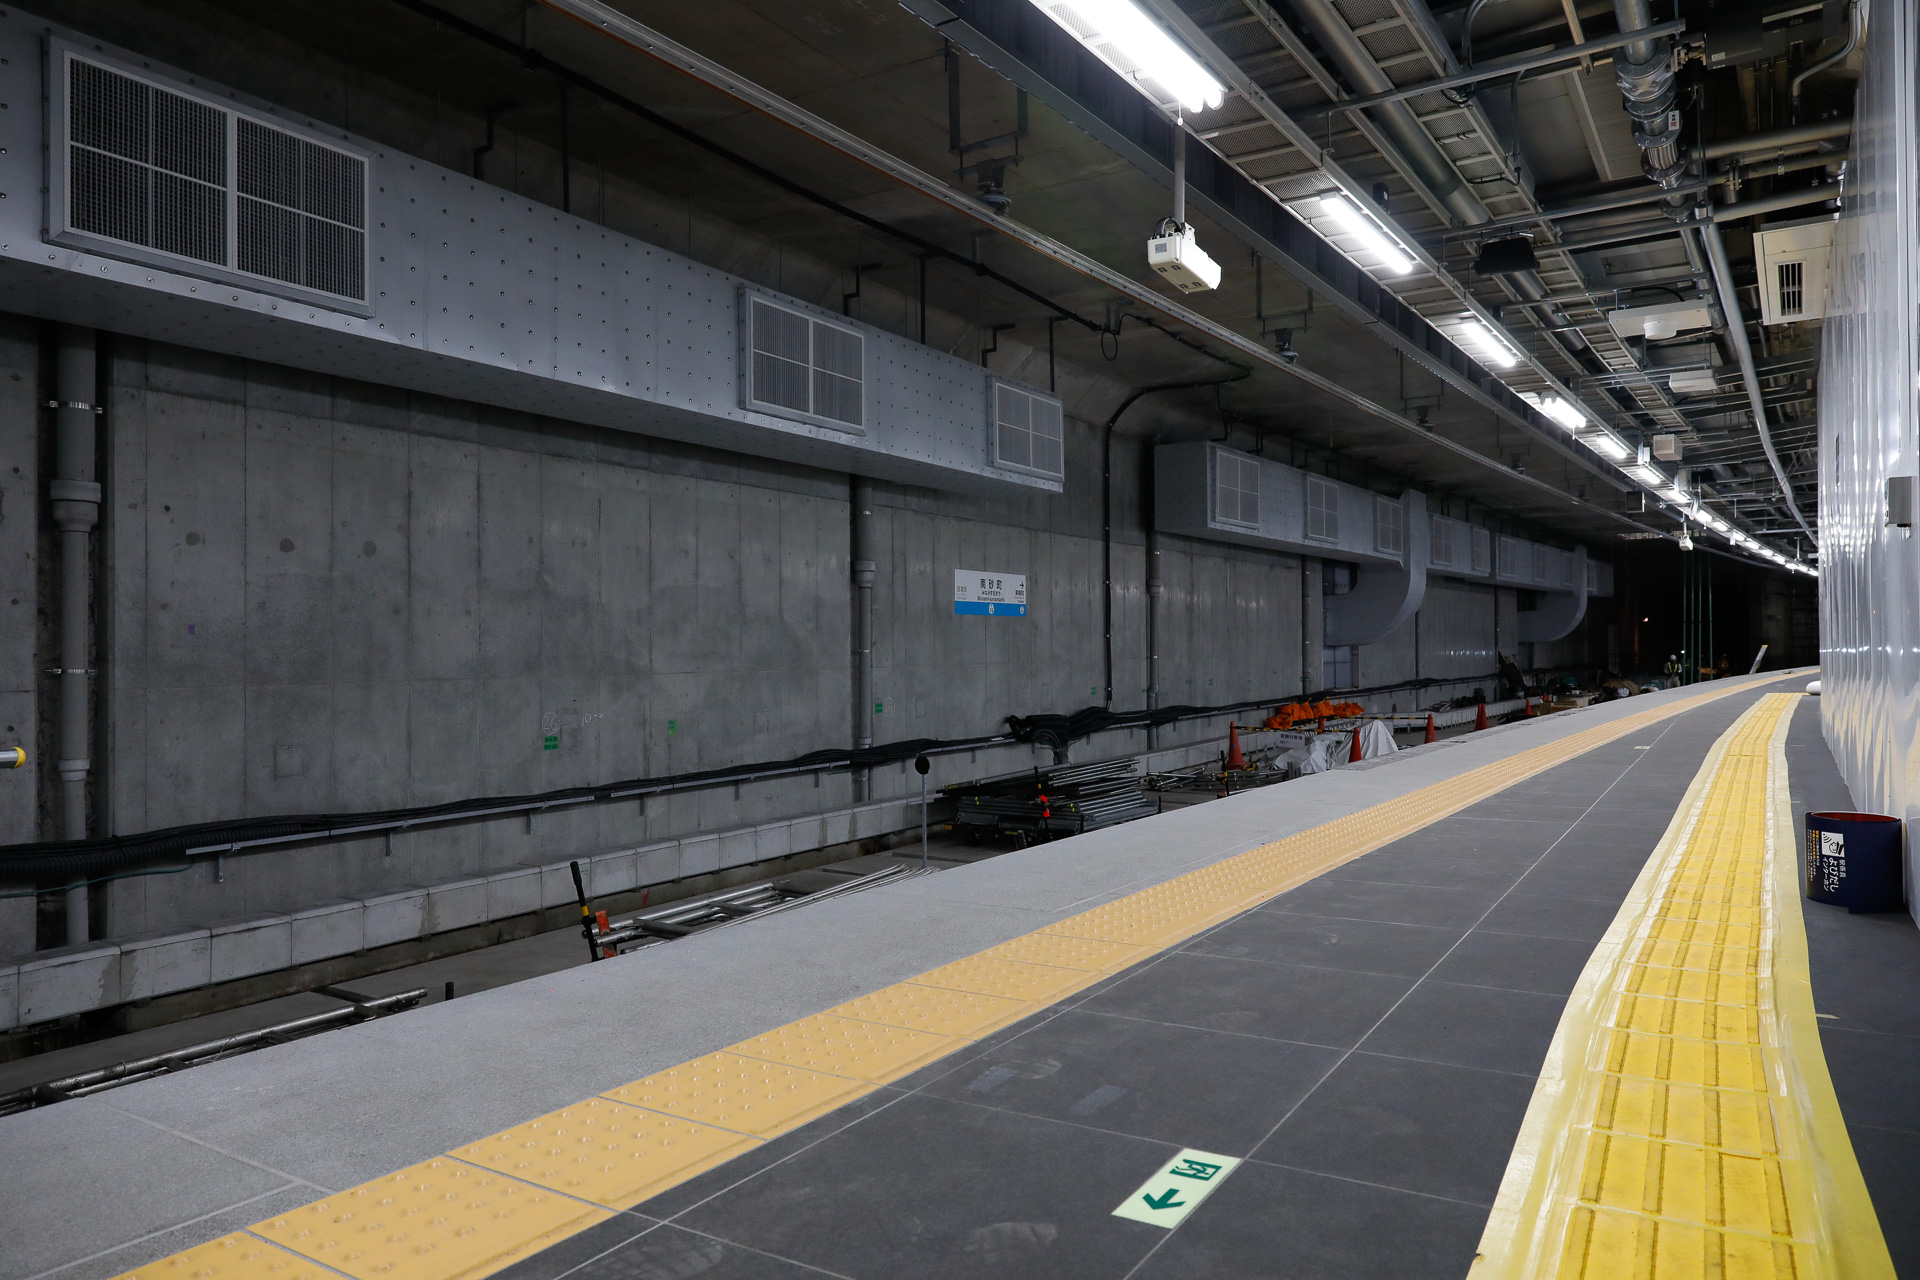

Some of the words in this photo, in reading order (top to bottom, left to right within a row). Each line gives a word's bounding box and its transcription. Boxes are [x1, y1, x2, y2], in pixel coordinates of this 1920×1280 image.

[980, 578, 1003, 590] 南砂町
[543, 715, 558, 731] 26
[1829, 857, 1839, 892] よびだし
